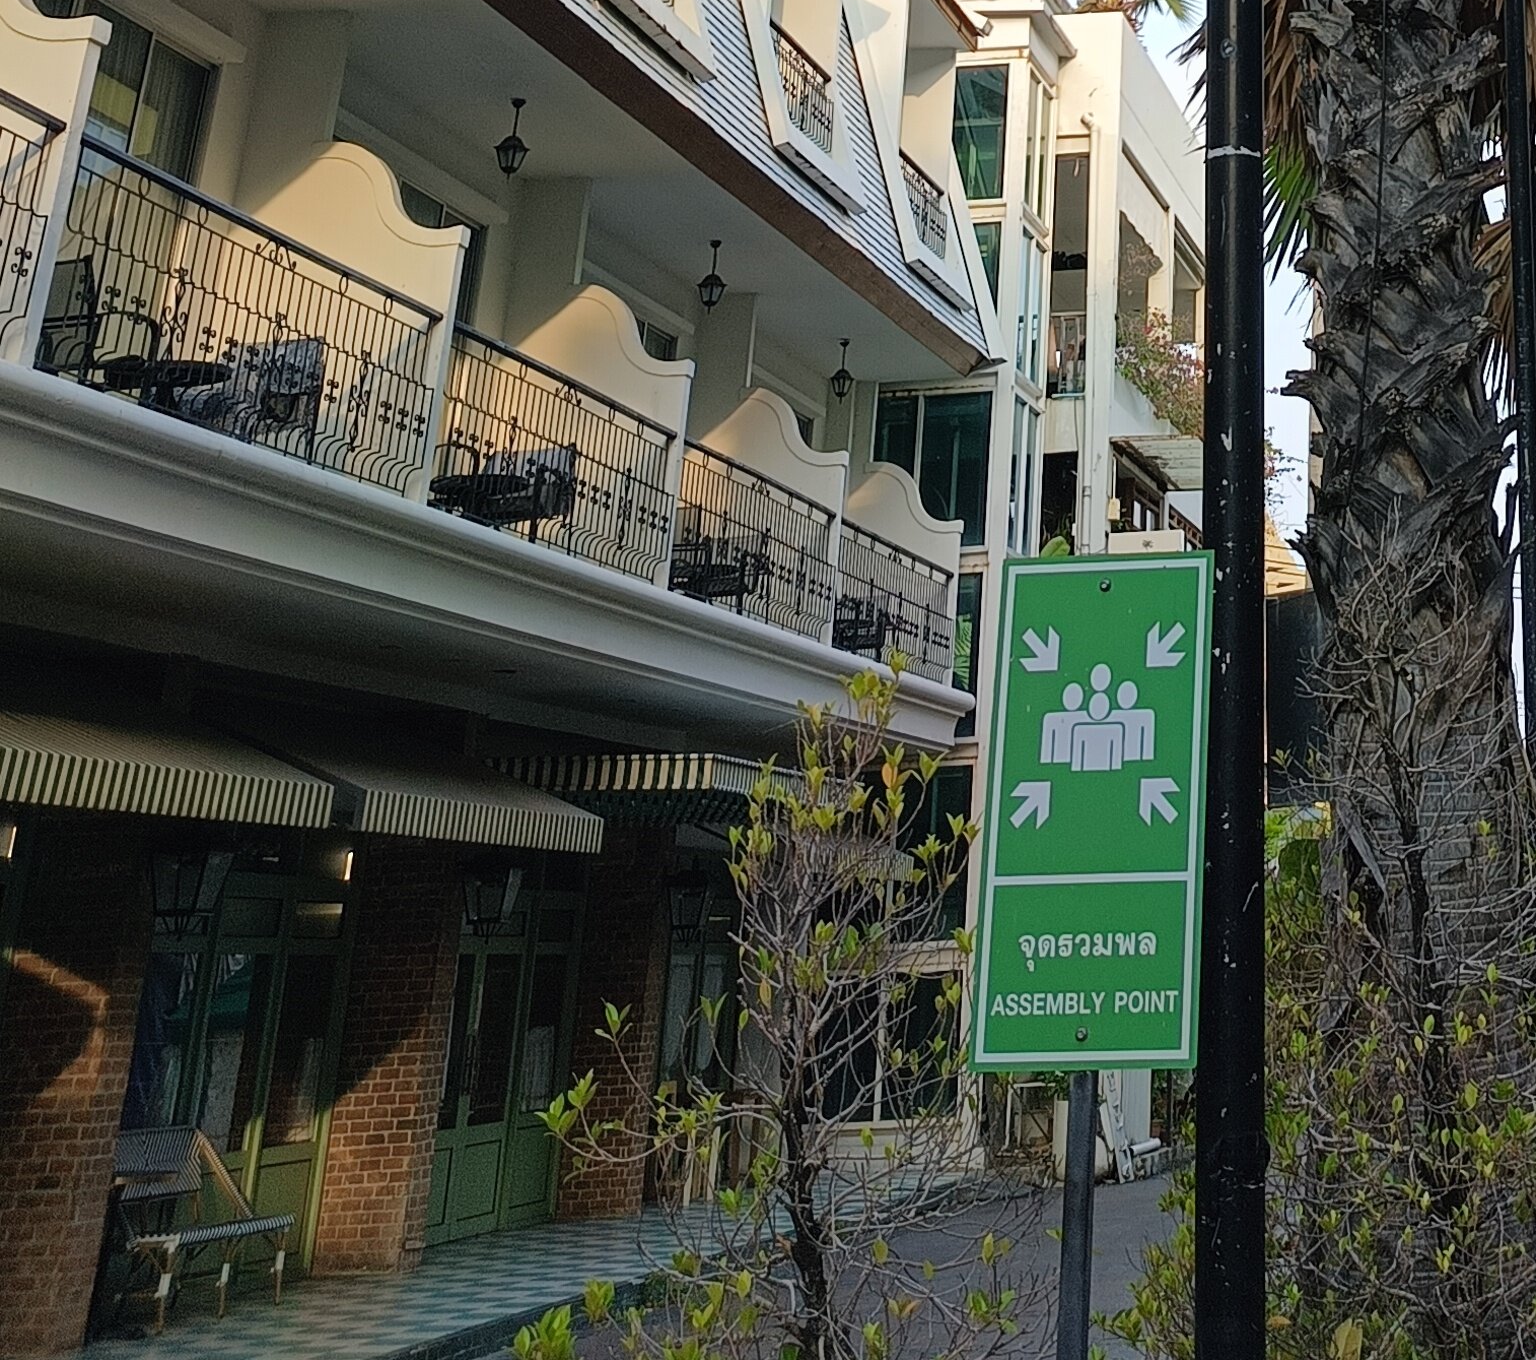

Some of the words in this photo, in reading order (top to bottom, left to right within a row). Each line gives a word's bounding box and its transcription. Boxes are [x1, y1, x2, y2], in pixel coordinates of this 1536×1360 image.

[1018, 931, 1158, 972] จุดรวมพล
[990, 991, 1106, 1017] ASSEMBLY
[1114, 990, 1180, 1014] POINT
